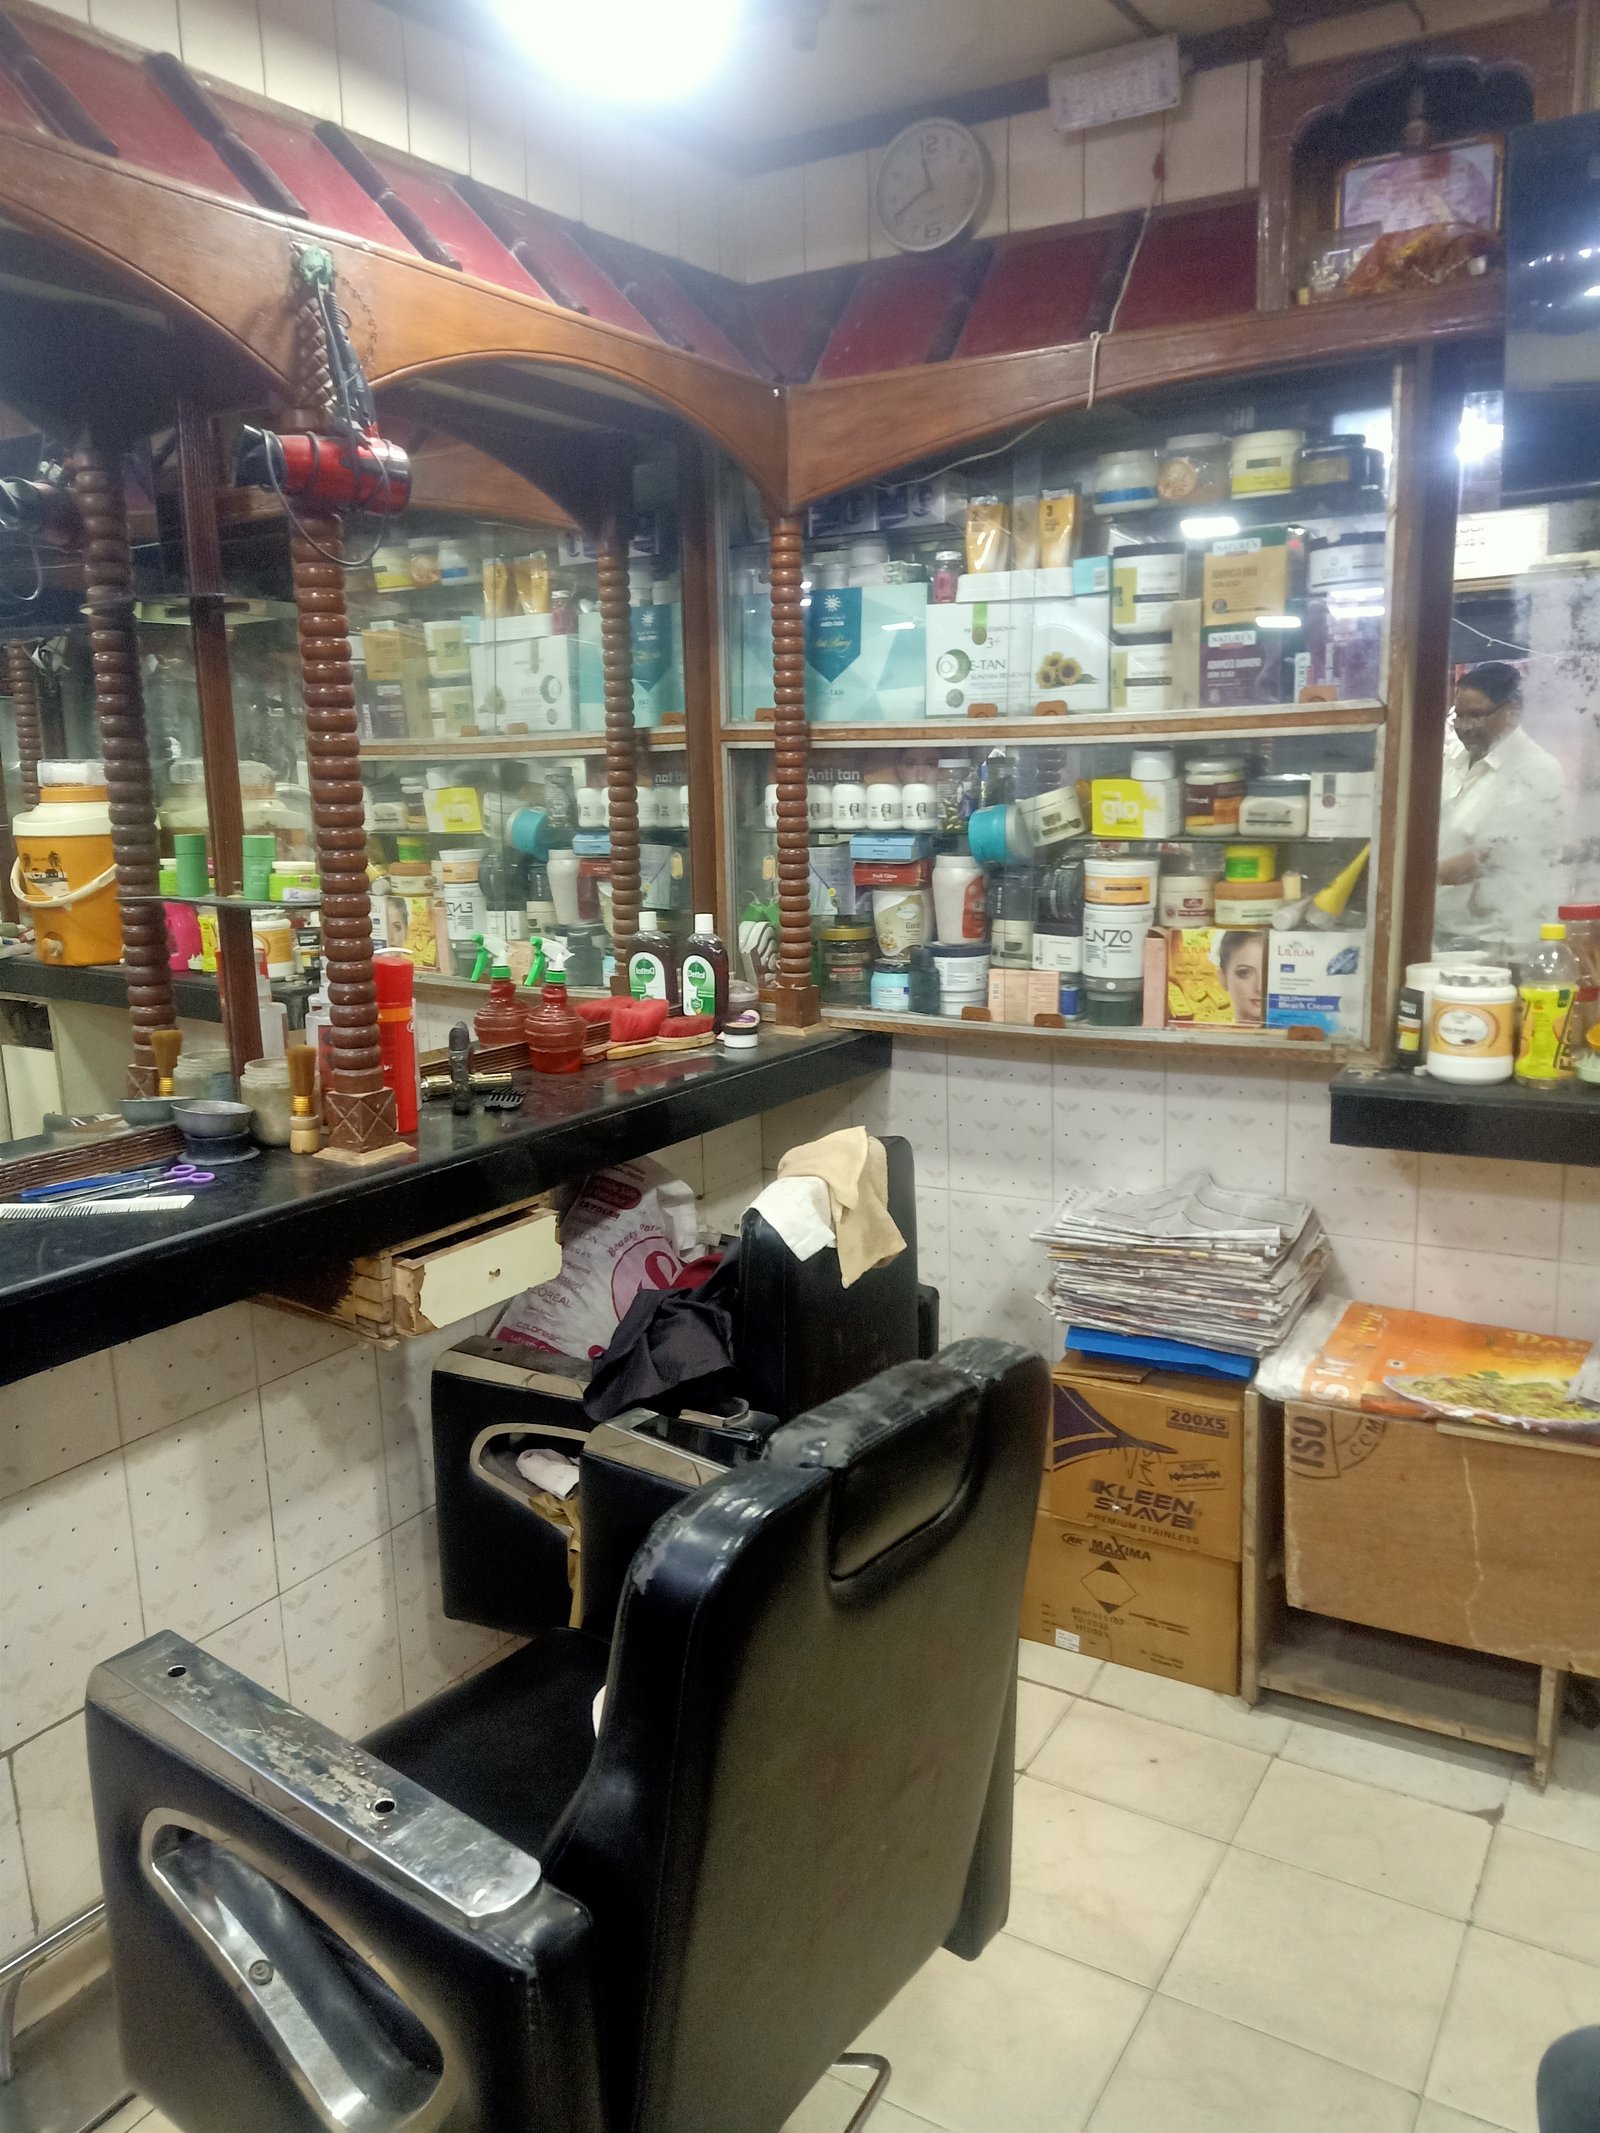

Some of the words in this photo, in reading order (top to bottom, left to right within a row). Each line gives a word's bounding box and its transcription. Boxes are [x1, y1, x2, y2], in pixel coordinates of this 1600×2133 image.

[807, 768, 834, 781] Anti
[837, 769, 860, 781] tan
[1084, 929, 1133, 948] ENZO
[688, 969, 706, 978] Dettol
[1170, 1409, 1227, 1430] 200X5
[1290, 1415, 1328, 1469] ISO
[1092, 1479, 1195, 1515] KLEEN
[1094, 1496, 1196, 1530] SHAVE
[1086, 1512, 1137, 1530] PREMIUM
[1141, 1525, 1200, 1545] STAINLESS
[1089, 1535, 1151, 1562] MAXIMA
